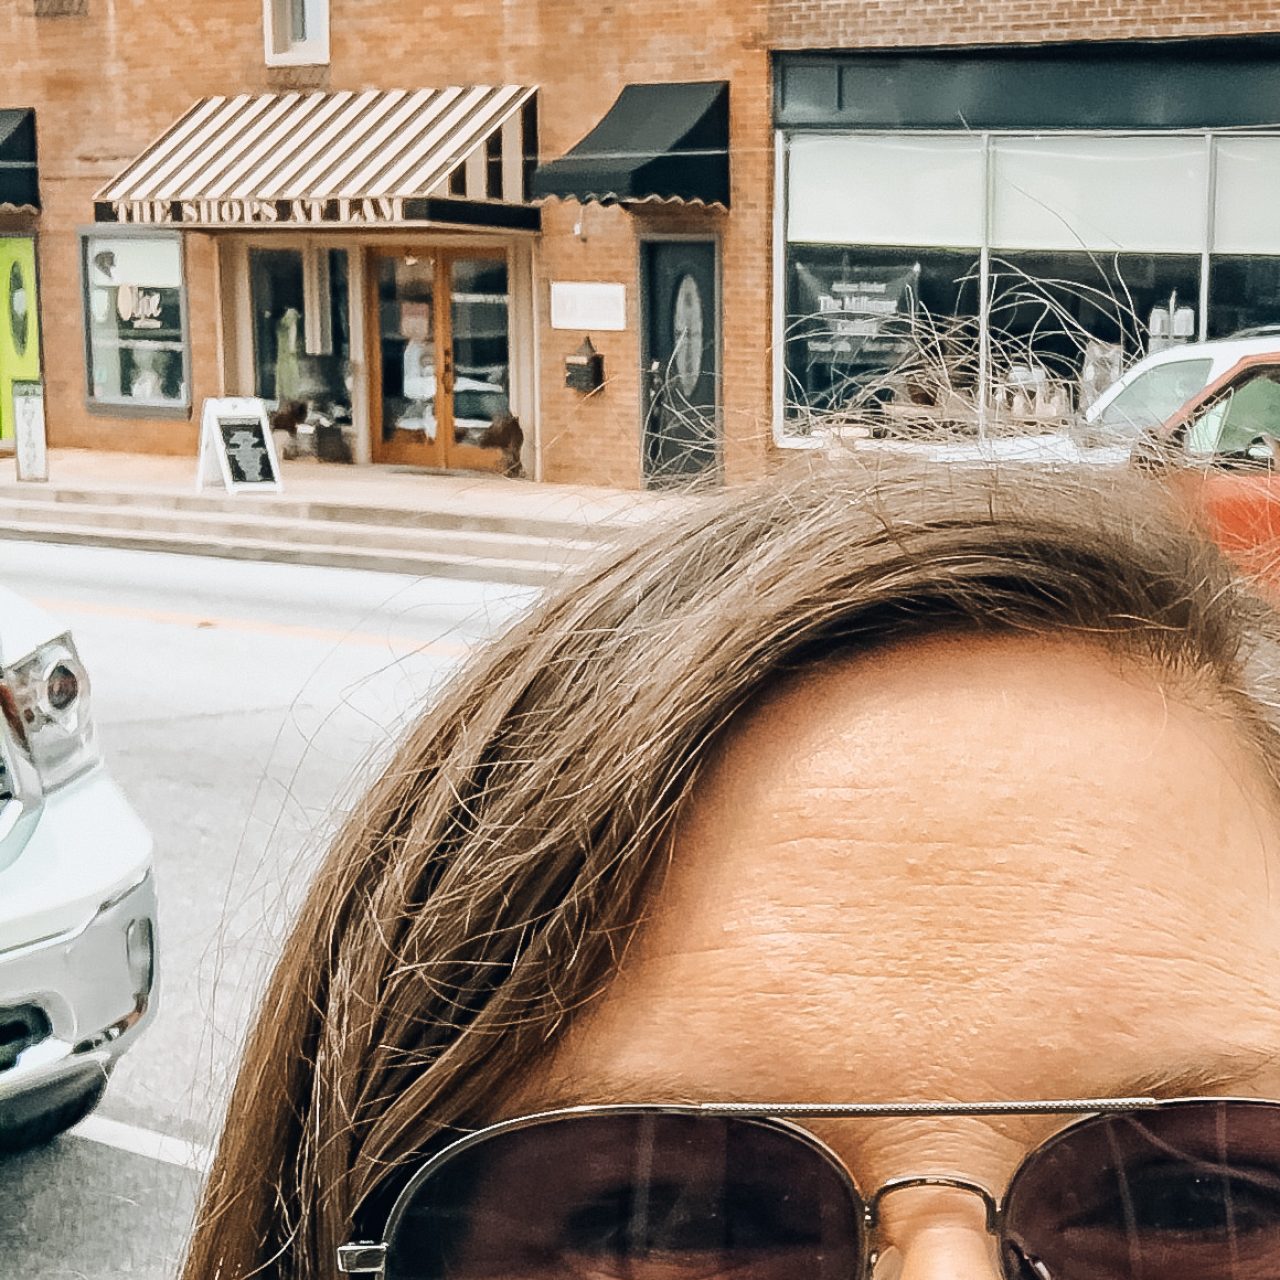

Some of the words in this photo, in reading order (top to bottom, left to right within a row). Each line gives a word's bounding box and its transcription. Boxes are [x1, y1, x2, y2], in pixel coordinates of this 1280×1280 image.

[113, 200, 172, 224] THE
[182, 200, 278, 224] SHOPS
[291, 199, 327, 224] AT
